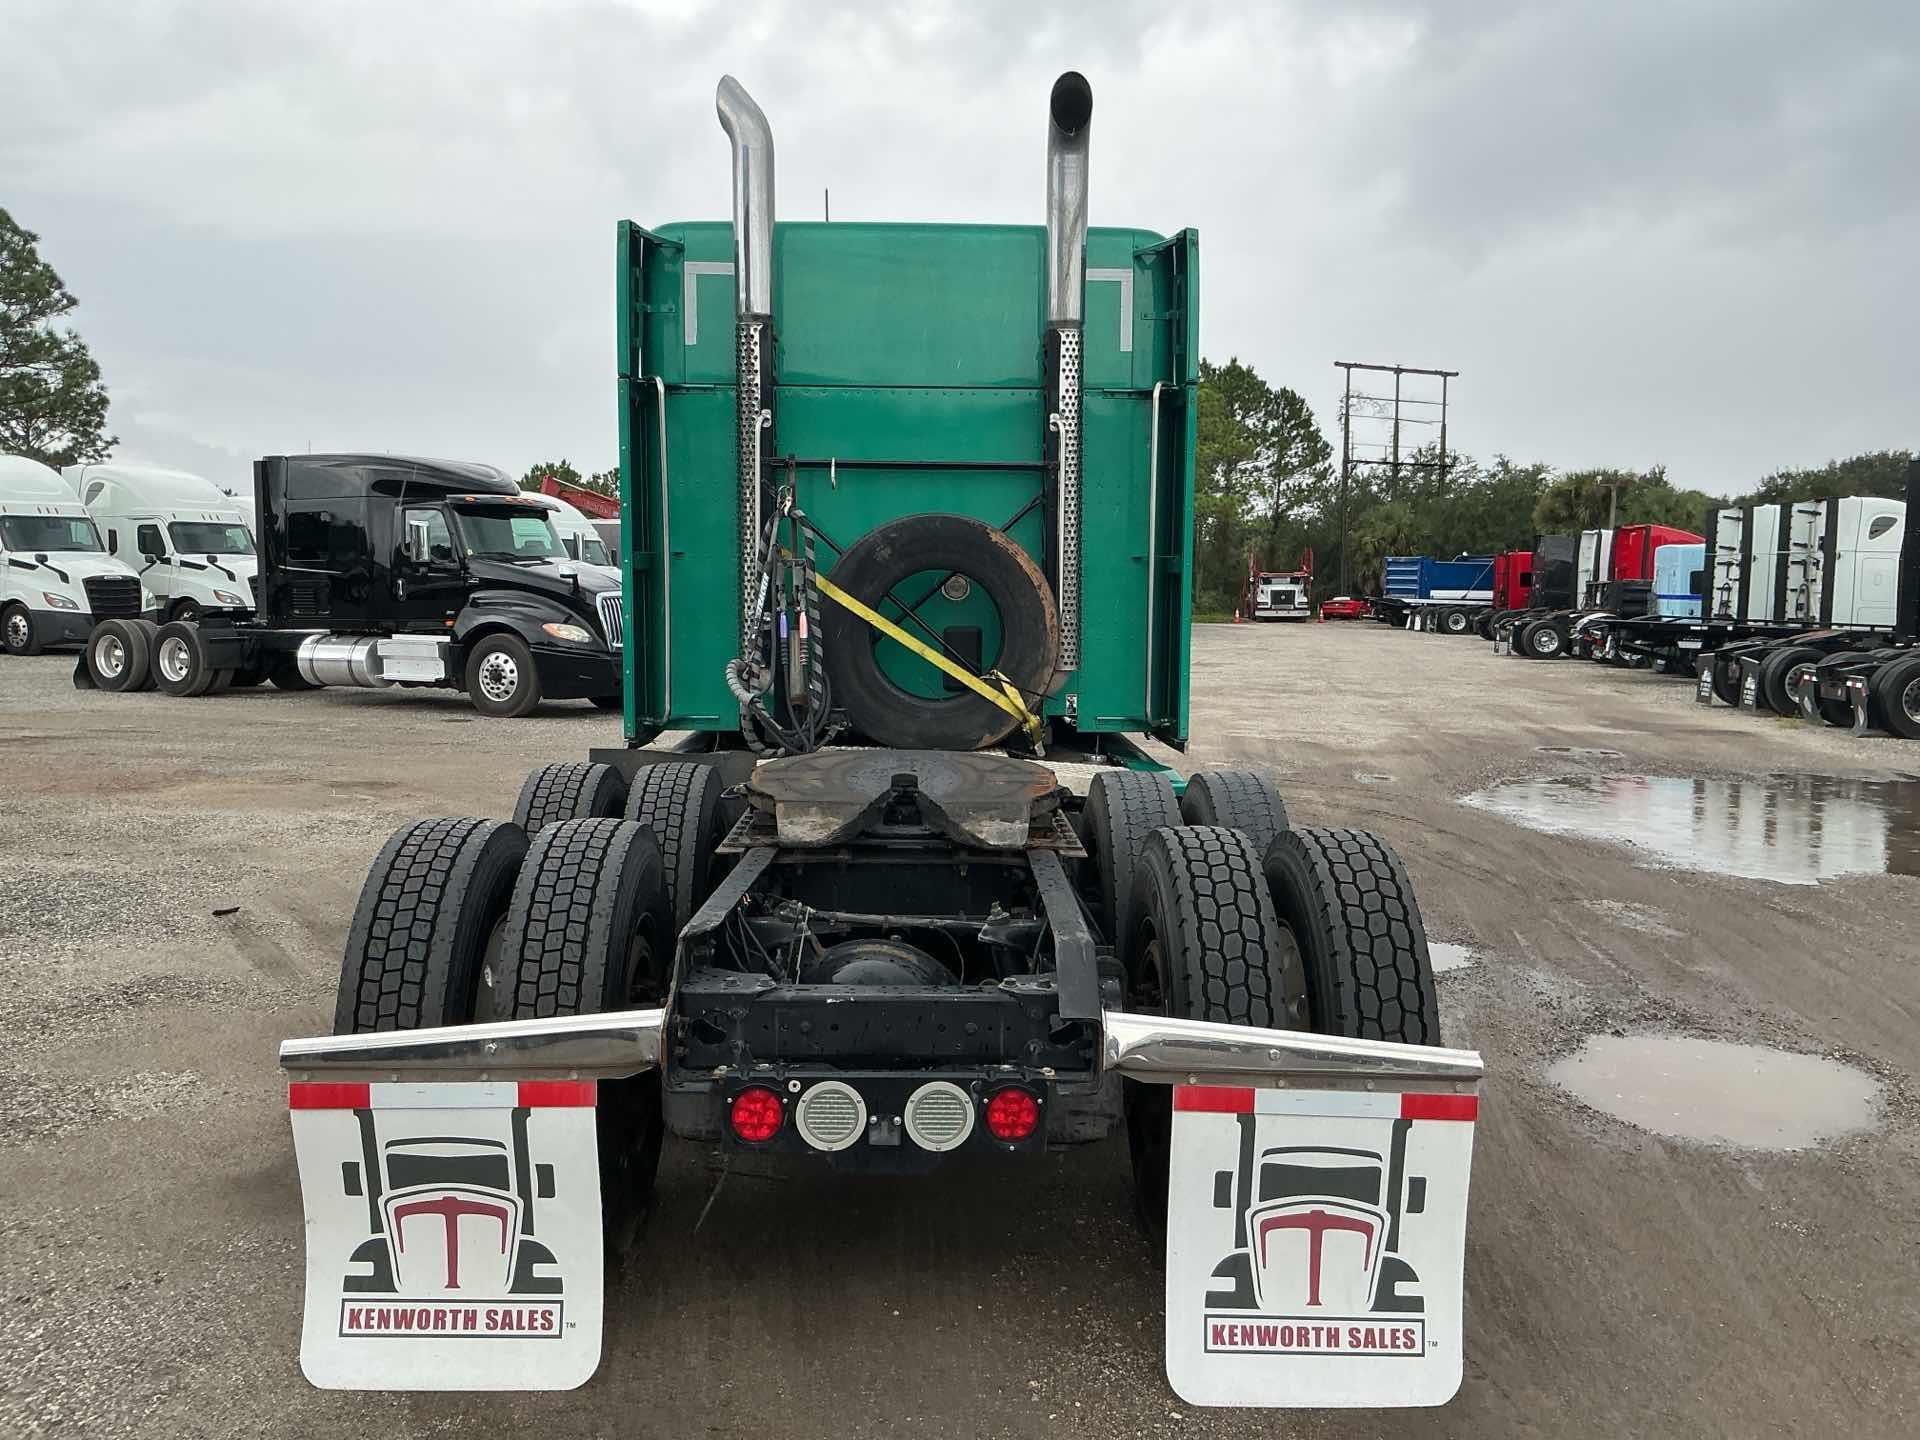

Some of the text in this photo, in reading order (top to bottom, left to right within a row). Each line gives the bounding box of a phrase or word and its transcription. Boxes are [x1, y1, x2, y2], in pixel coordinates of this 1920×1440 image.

[348, 1308, 477, 1330] KENWORTH
[485, 1309, 554, 1331] SALES
[1212, 1324, 1439, 1349] KENWORTH SALES TM
